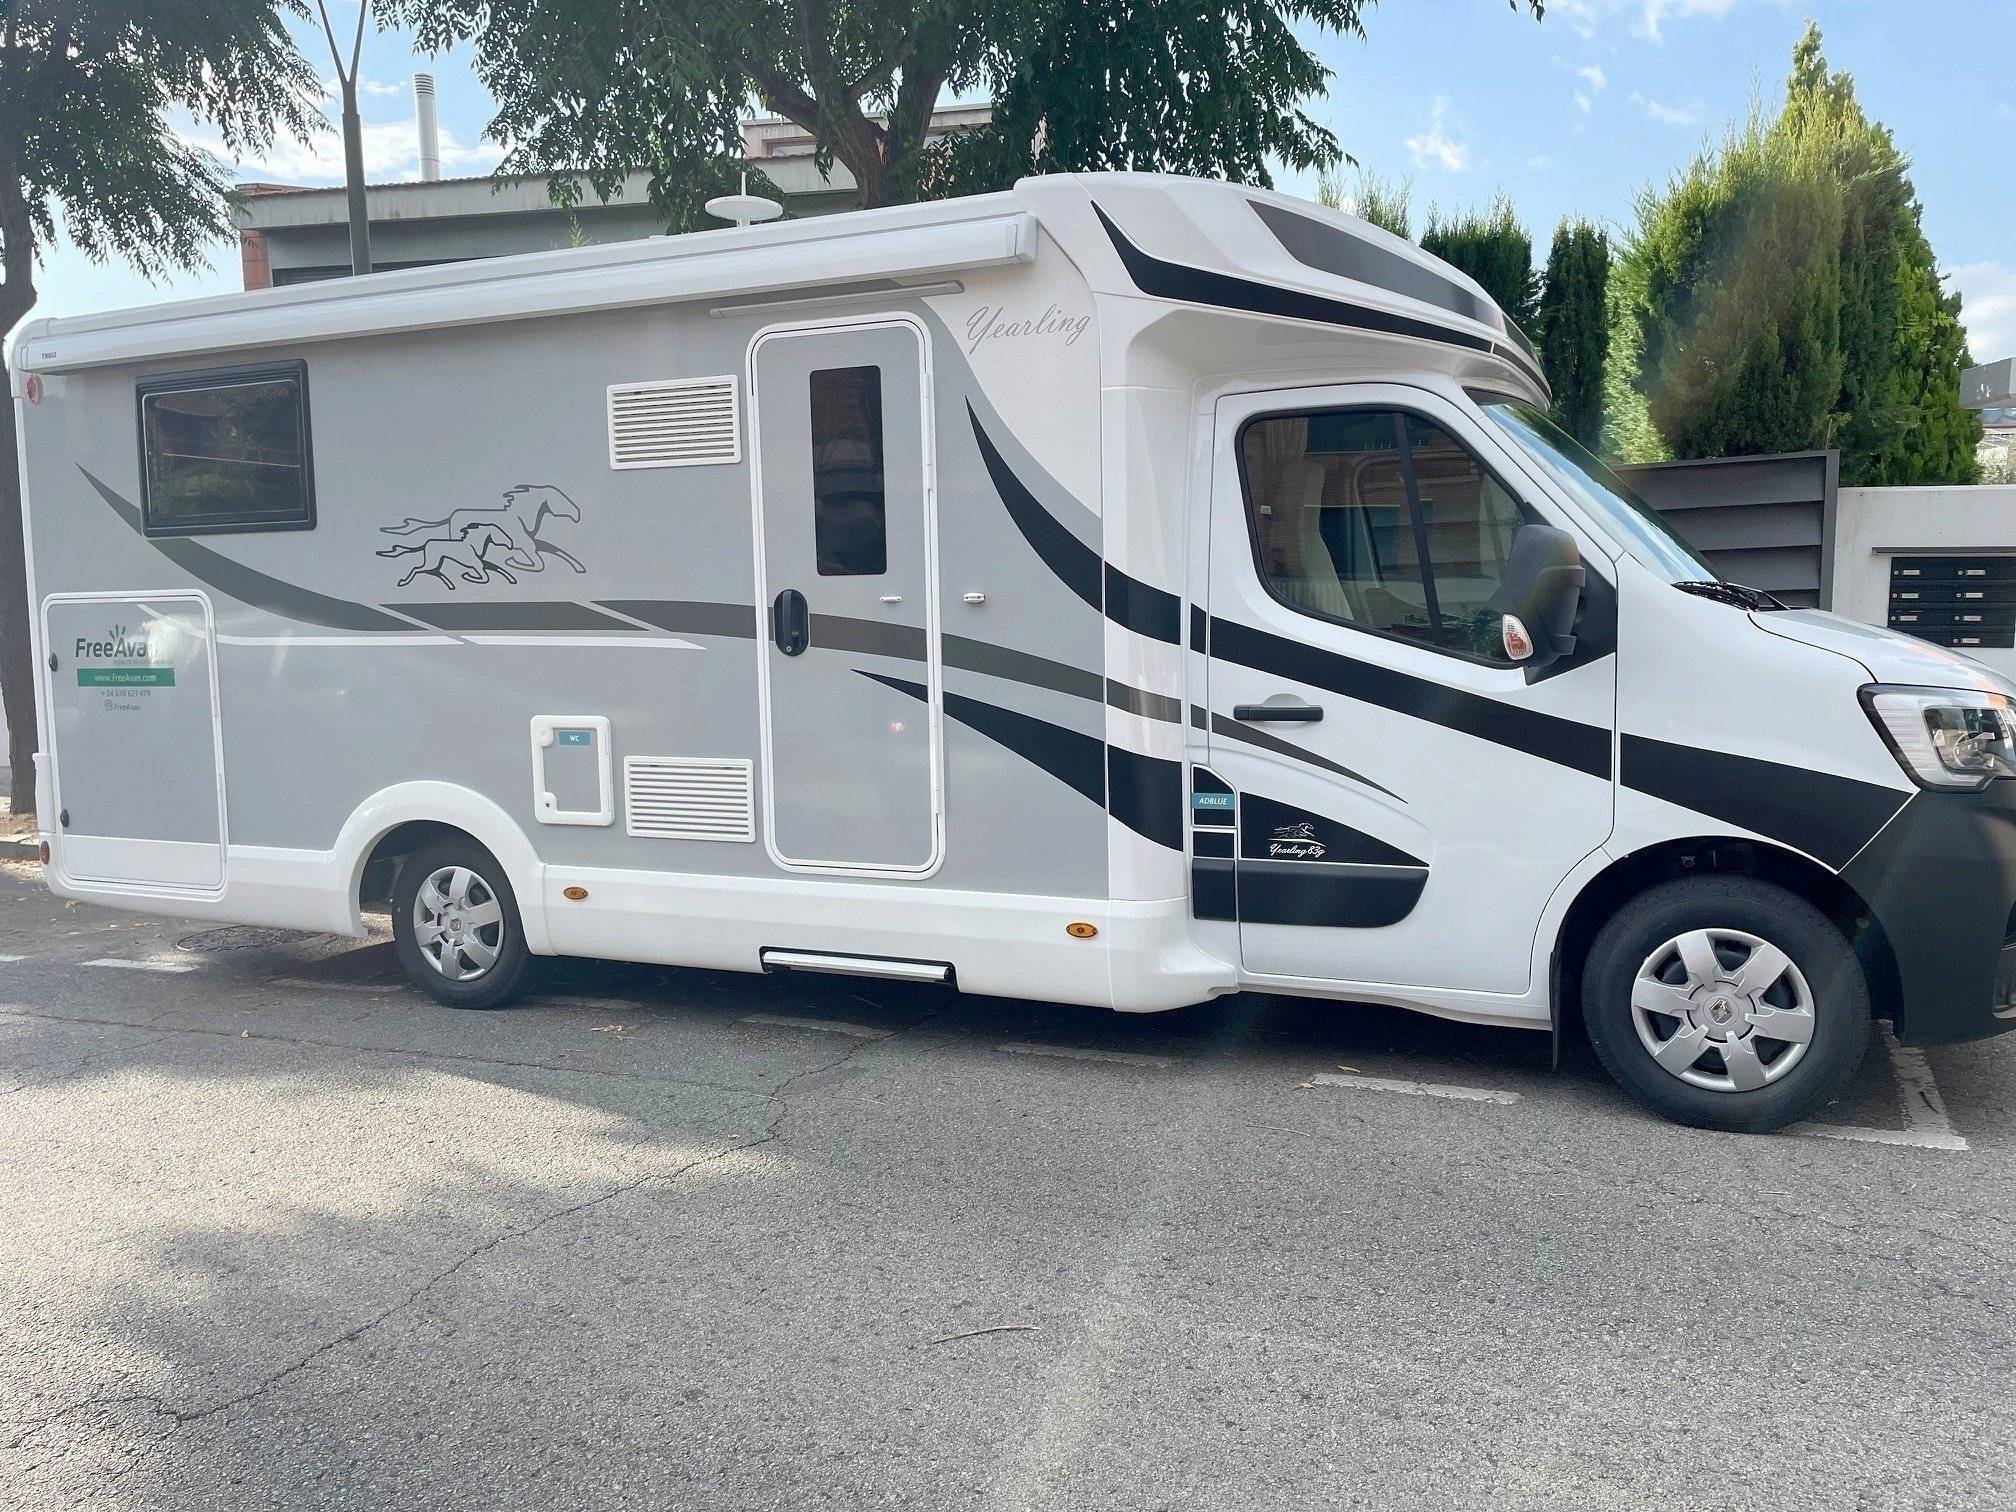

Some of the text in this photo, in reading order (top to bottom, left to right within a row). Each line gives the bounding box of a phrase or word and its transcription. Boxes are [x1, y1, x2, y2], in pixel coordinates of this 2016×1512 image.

[966, 303, 1091, 355] Yearling
[75, 638, 149, 658] FreeAva
[569, 734, 580, 742] WC
[1198, 797, 1228, 805] ADBLUE
[1269, 843, 1307, 858] Yearling
